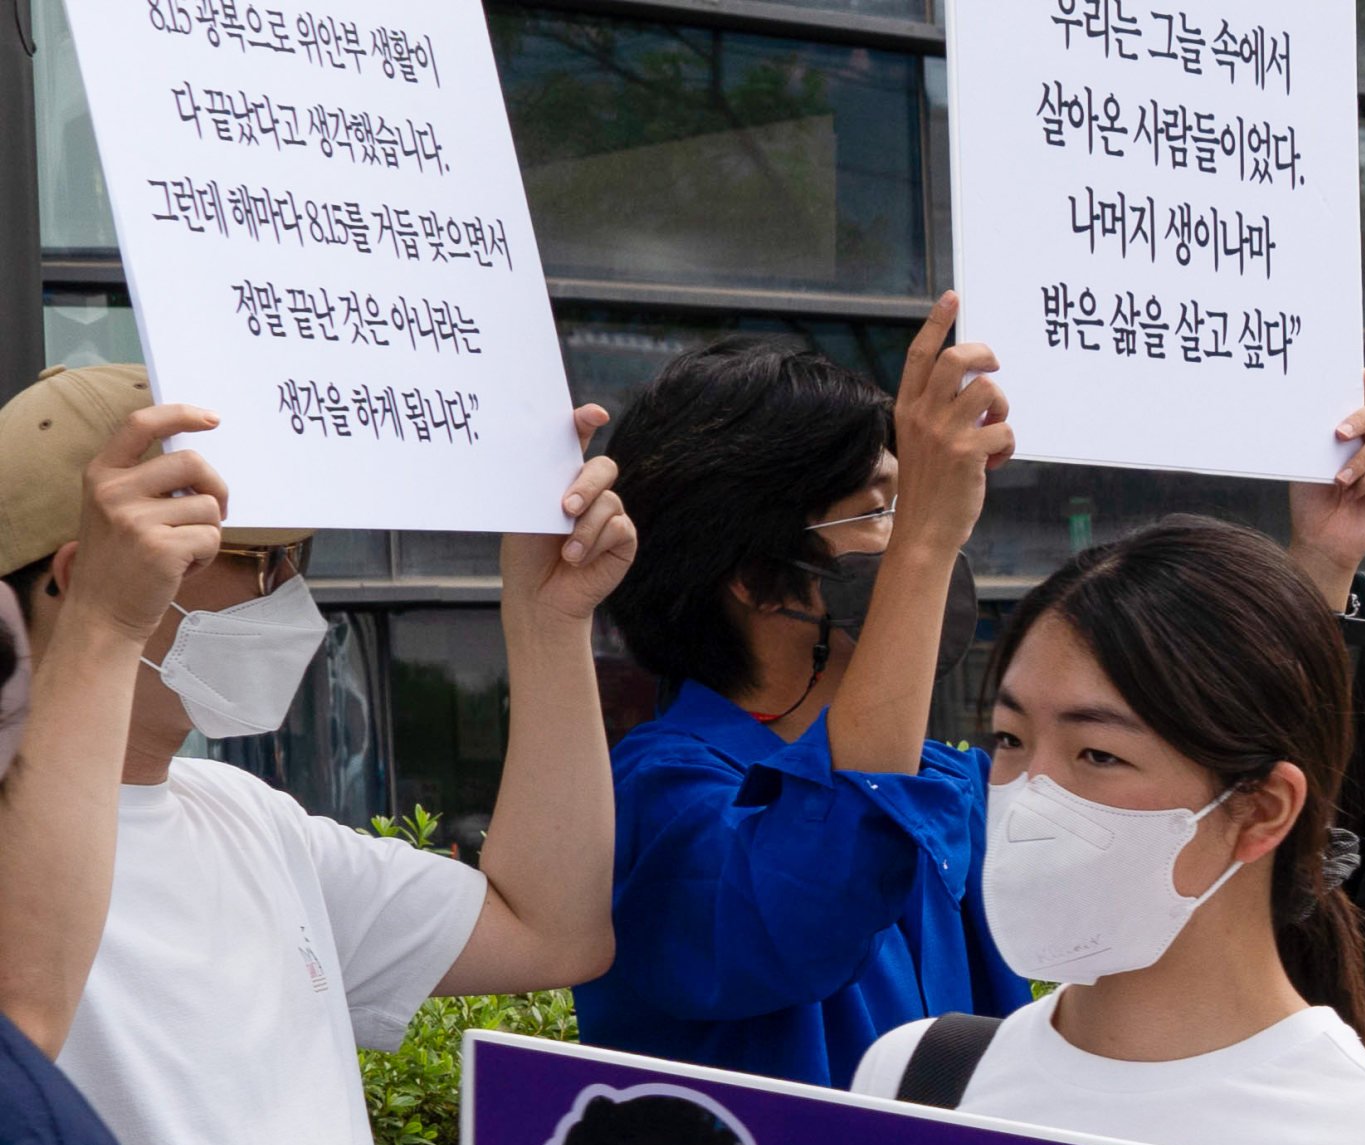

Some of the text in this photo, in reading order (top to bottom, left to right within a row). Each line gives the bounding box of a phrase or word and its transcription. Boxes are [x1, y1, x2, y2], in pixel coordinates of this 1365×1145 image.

[196, 0, 296, 53] 광복으로
[297, 12, 366, 73] 위안부
[371, 27, 440, 88] 생활이
[1051, 0, 1291, 96] 우리는 그늘 속에서
[172, 81, 449, 176] 다 끝났다고 생각했습니다.
[1036, 81, 1305, 190] 살아온 사람들이었다.
[147, 177, 229, 237] 그런데
[228, 184, 303, 246] 해마다
[371, 204, 420, 261] 거듭
[418, 211, 513, 271] 맞으면서
[1069, 187, 1276, 280] 나머지 생이나마
[234, 280, 482, 354] 정말 끝난 것은 아니라는
[1041, 282, 1103, 351] 밝은
[1110, 290, 1169, 359] 삶을
[1175, 300, 1233, 363] 살고
[279, 380, 351, 438] 생각을
[350, 385, 405, 441] 하게
